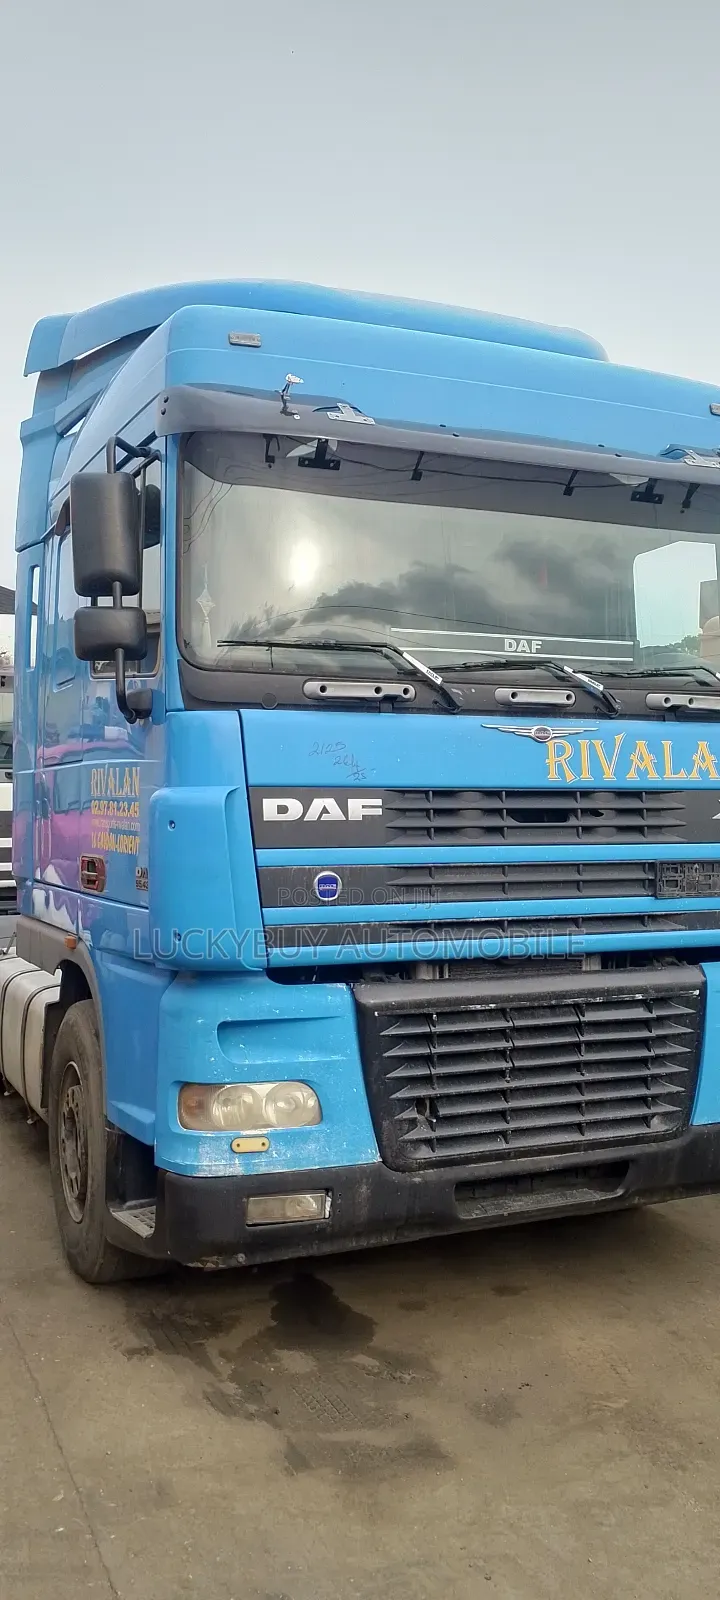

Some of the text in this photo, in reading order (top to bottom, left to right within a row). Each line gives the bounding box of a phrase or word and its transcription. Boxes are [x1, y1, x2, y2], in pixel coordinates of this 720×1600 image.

[504, 638, 542, 653] DAF
[546, 732, 720, 784] RIVALA
[91, 763, 140, 798] RIVALAN
[262, 798, 383, 821] DAF
